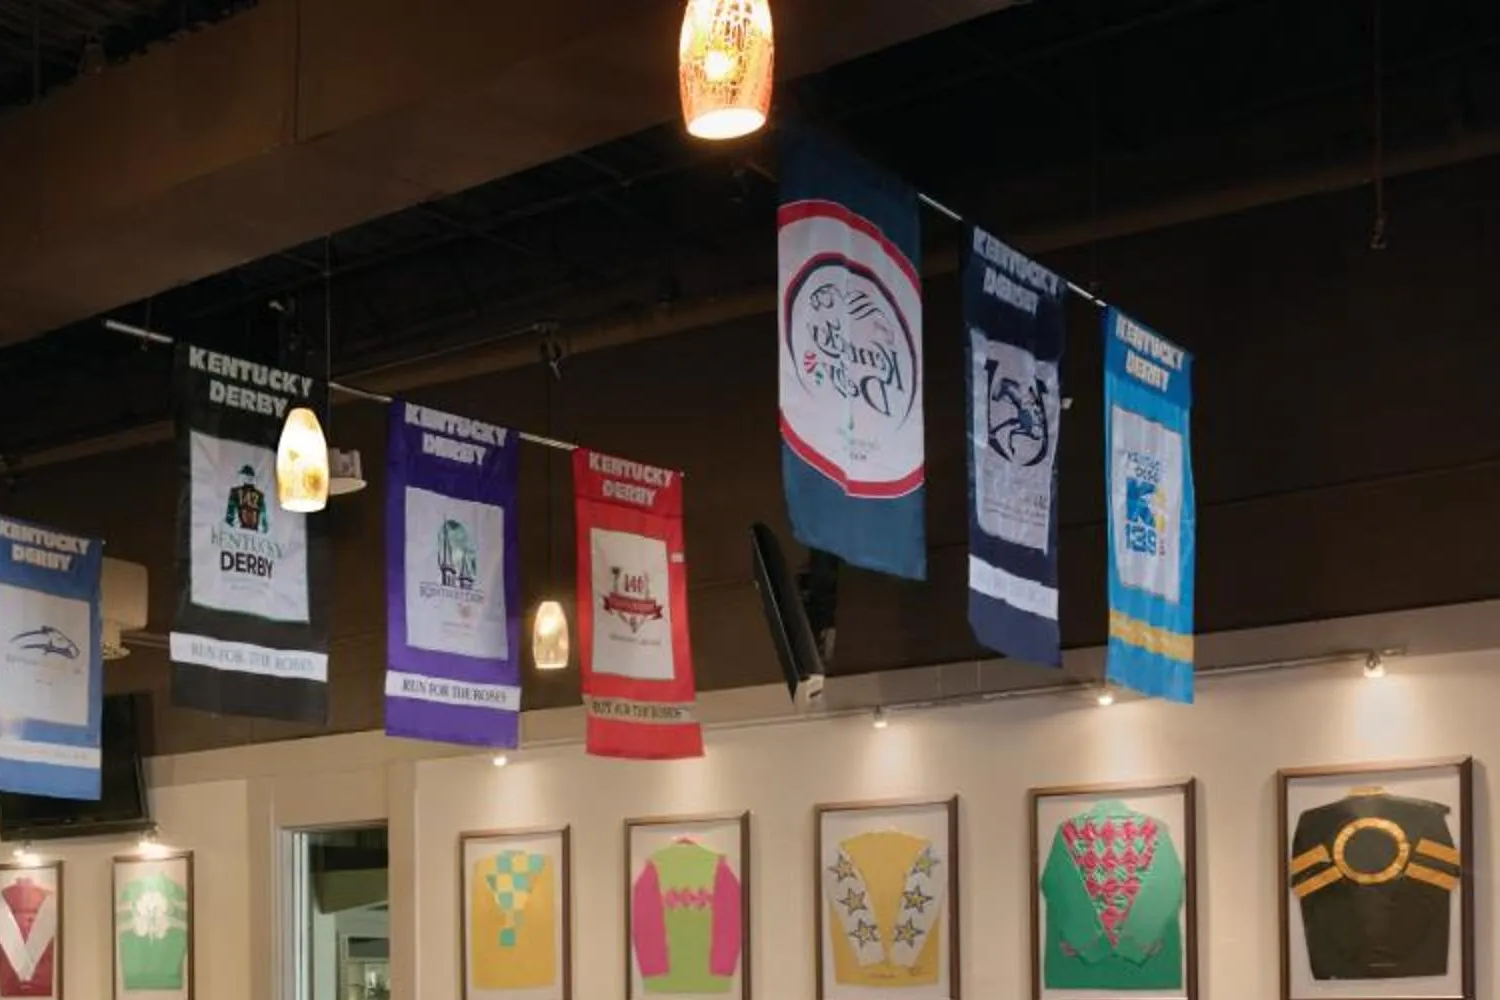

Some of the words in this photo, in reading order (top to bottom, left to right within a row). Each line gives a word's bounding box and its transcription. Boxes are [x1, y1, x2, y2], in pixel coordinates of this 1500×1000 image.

[972, 225, 1061, 294] KENTUCKY
[982, 267, 1040, 315] DERBY
[1115, 313, 1185, 372] KENTUCKY
[189, 346, 313, 398] KENTUCKY
[1125, 350, 1171, 393] DERBY
[209, 379, 288, 418] DERBY
[404, 402, 507, 447] KENTUCKY
[422, 432, 487, 466] DERBY
[589, 451, 674, 488] KENTUCKY
[602, 479, 657, 507] DERBY
[11, 545, 72, 571] DERBY
[220, 551, 274, 580] DERBY
[403, 679, 426, 693] RUN
[429, 683, 449, 697] FOR
[451, 686, 471, 700] THE
